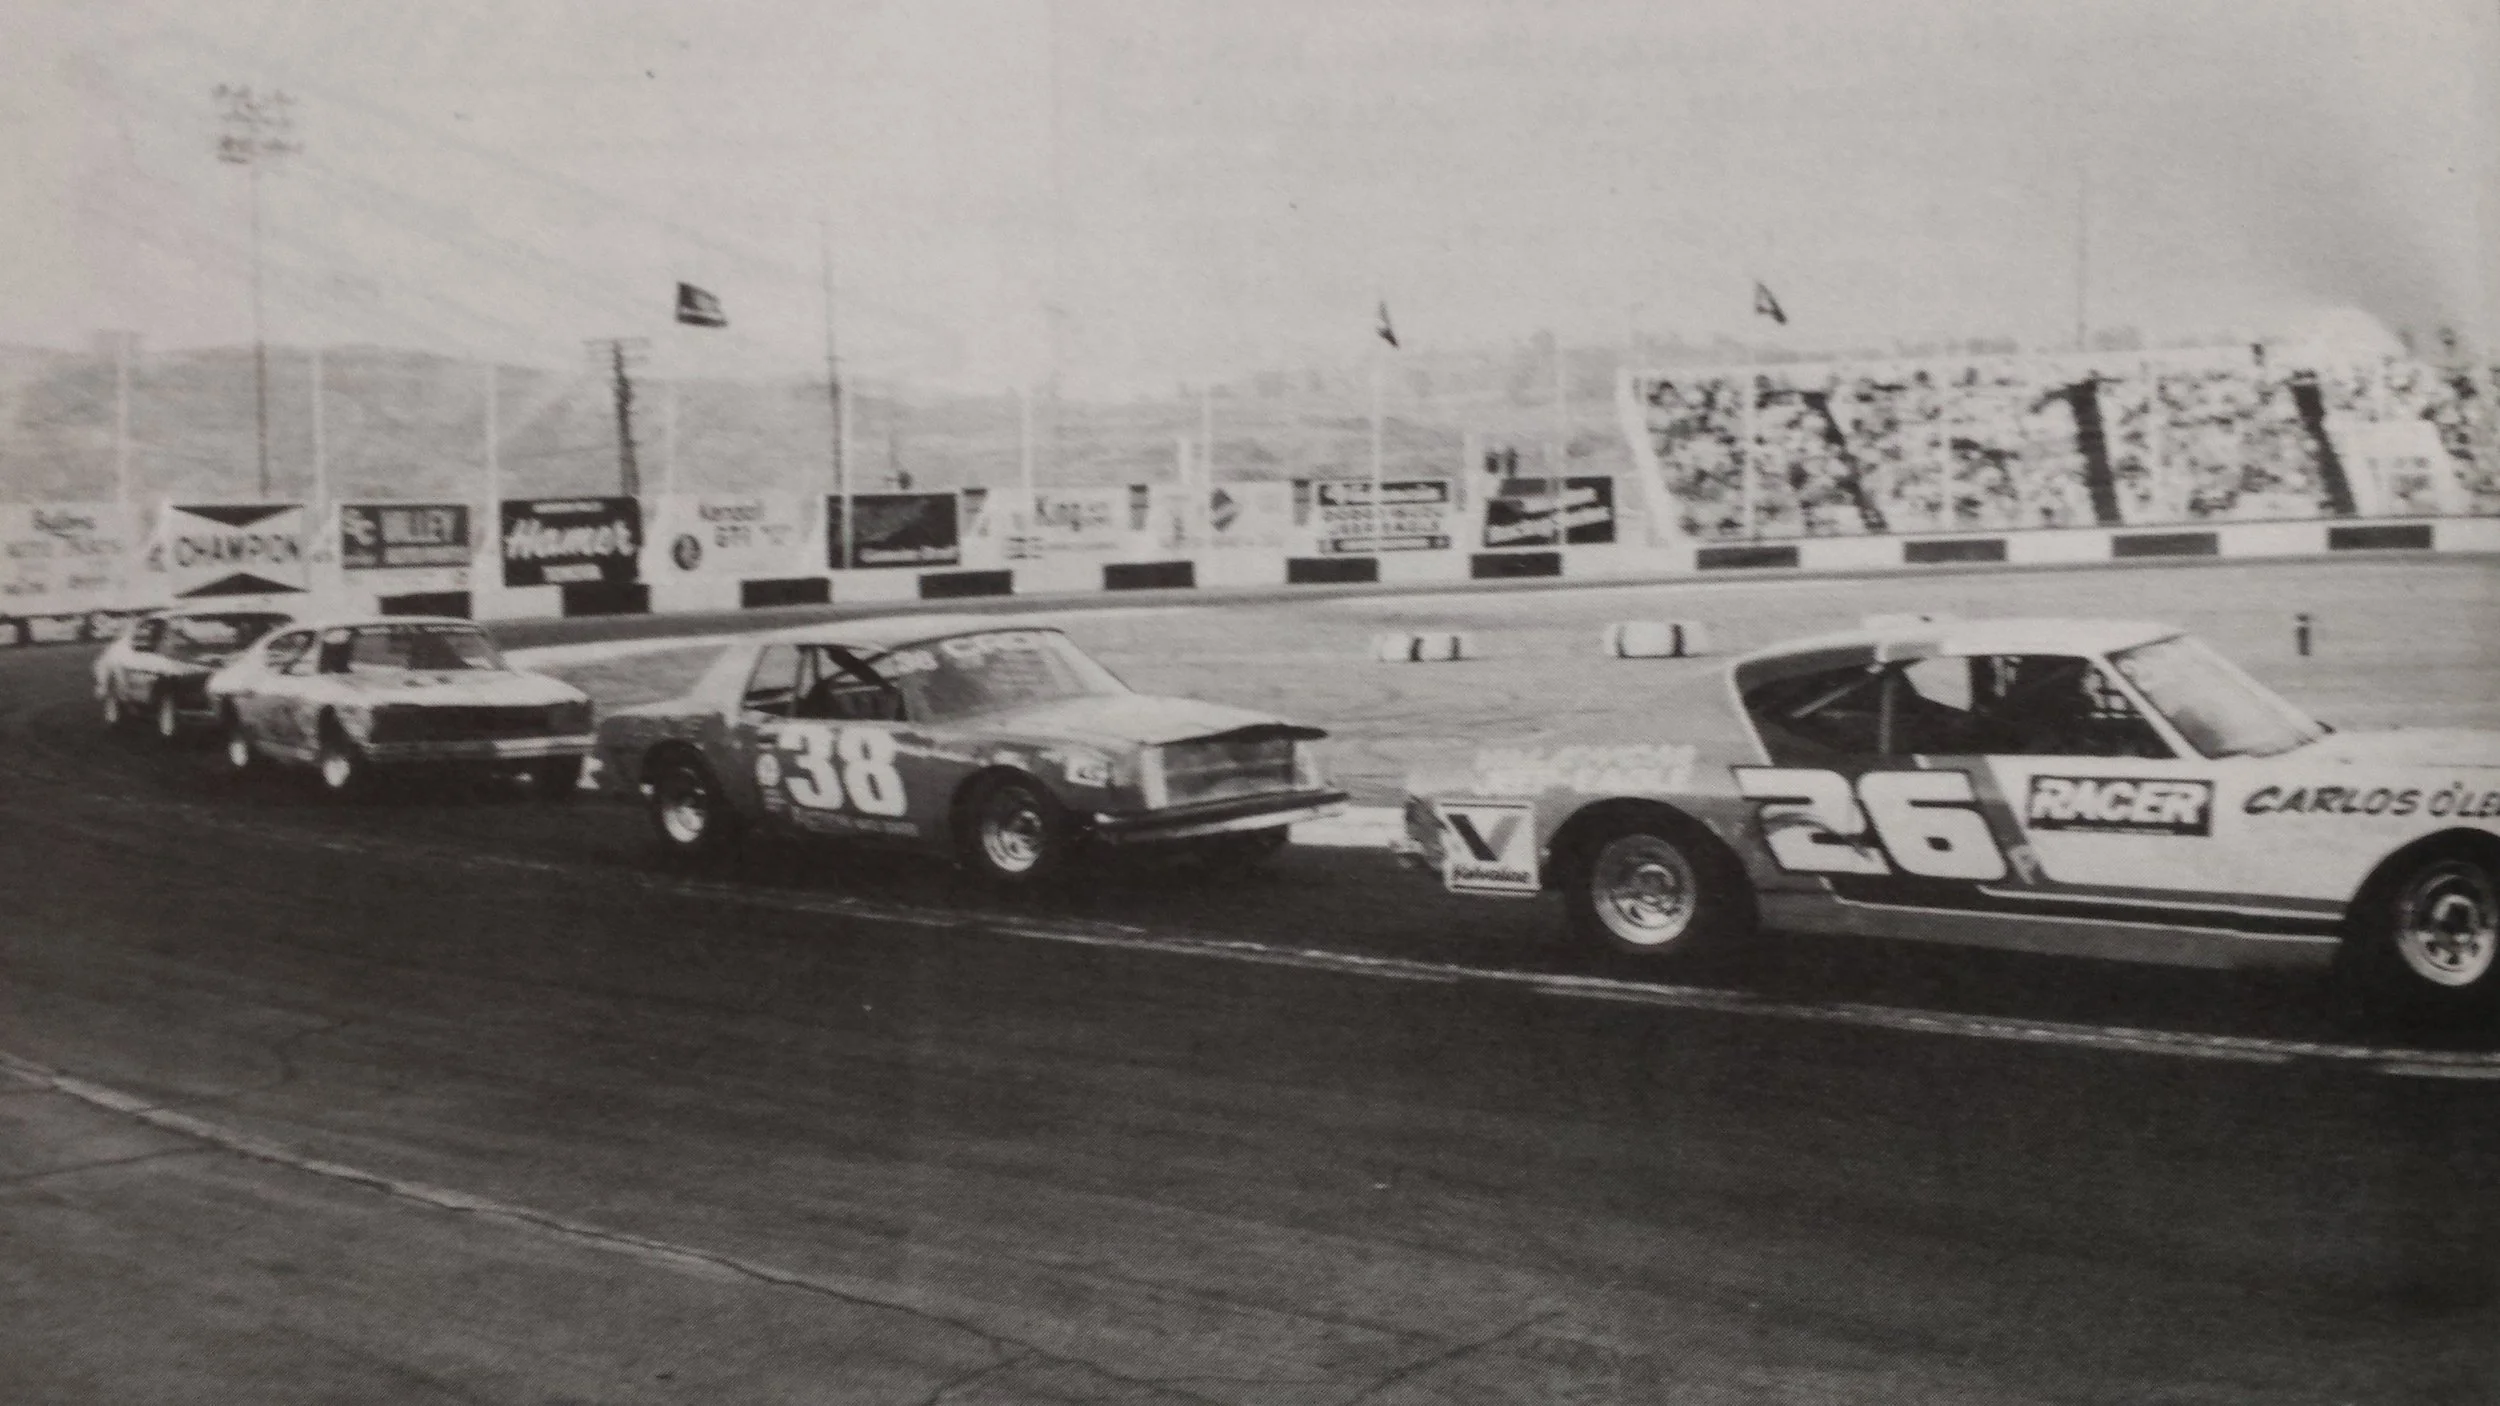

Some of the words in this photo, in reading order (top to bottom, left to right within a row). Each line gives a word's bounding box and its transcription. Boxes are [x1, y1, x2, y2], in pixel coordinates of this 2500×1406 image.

[175, 533, 301, 568] CHAMPION
[776, 723, 908, 817] 38
[1730, 765, 2008, 881] 26
[2030, 778, 2207, 825] RACER
[2242, 785, 2422, 815] CARLOS
